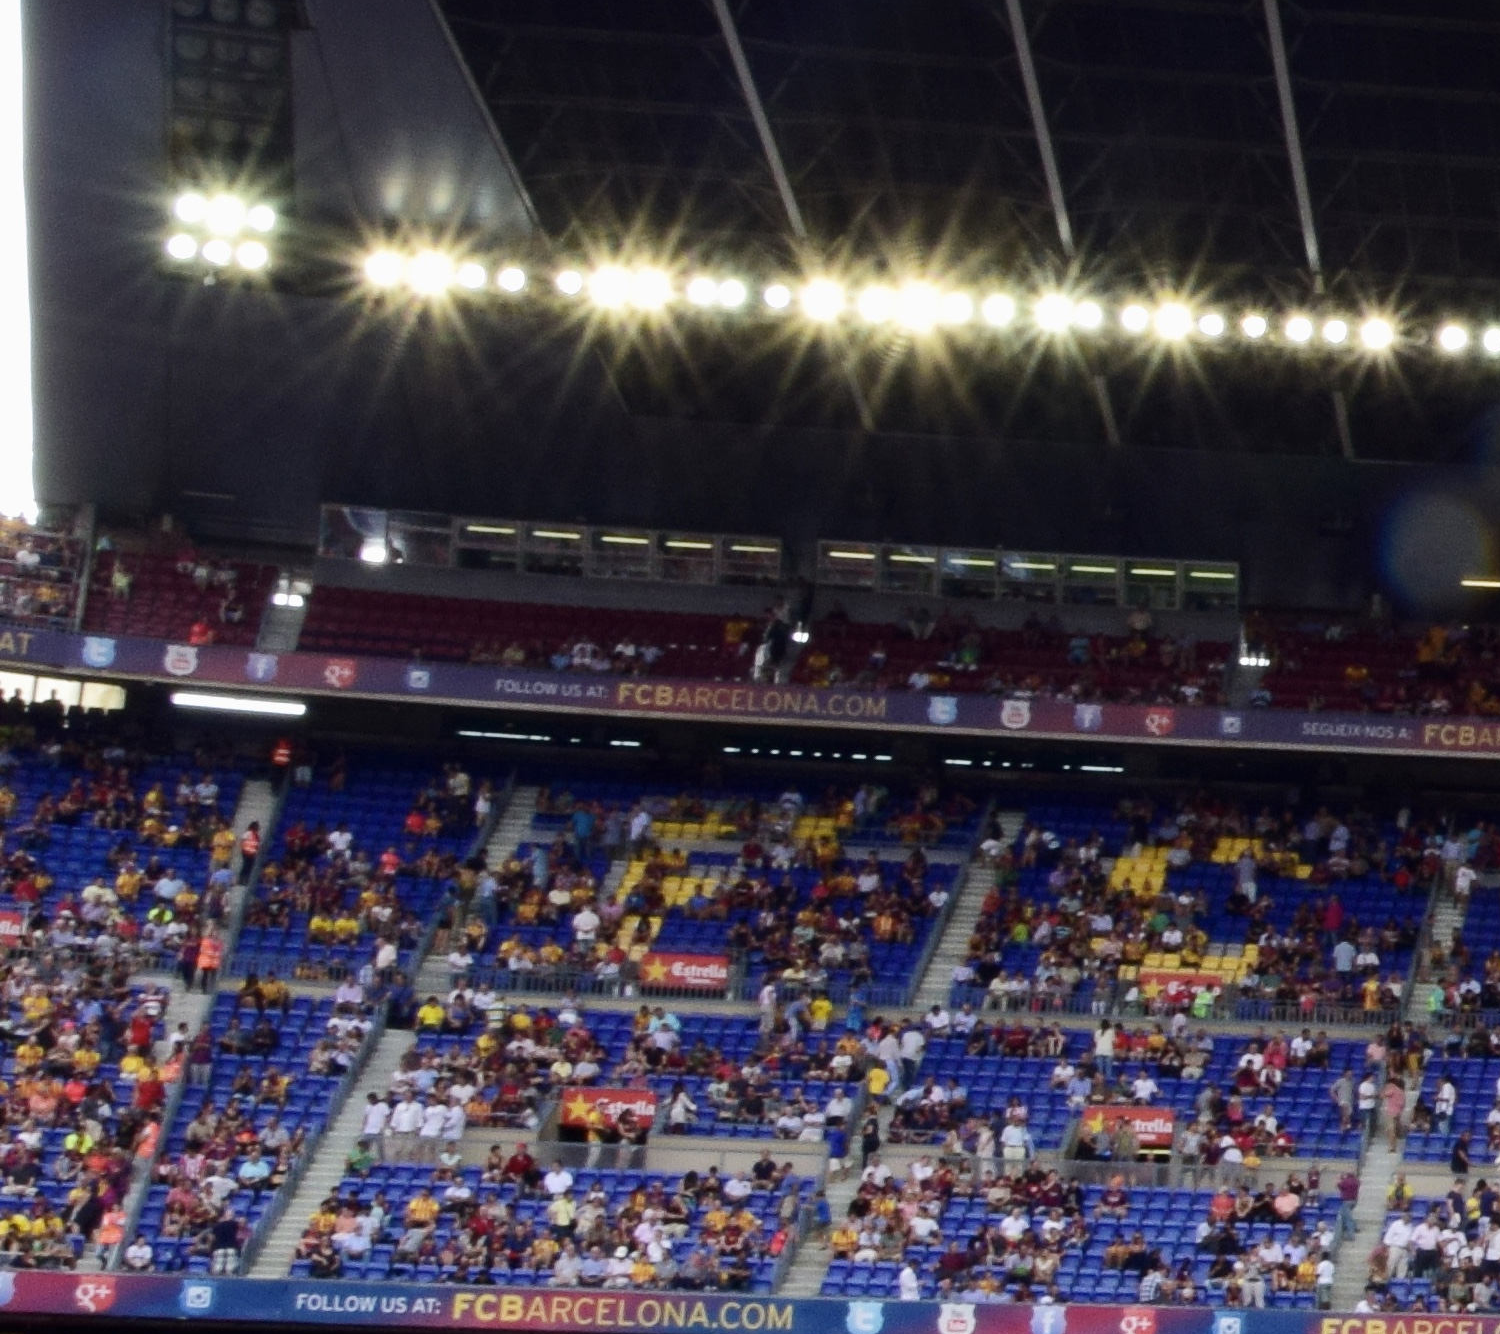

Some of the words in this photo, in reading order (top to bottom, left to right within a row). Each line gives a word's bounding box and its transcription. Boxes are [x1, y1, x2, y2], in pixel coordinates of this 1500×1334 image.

[496, 678, 556, 696] FOLLOW
[562, 683, 581, 698] US
[616, 682, 887, 717] FCBARCELONA.COM
[672, 962, 728, 978] Estrella
[296, 1292, 377, 1314] FOLLOW
[381, 1295, 407, 1314] US
[411, 1297, 441, 1316] AT:
[452, 1292, 795, 1330] FCBARCELONA.COM
